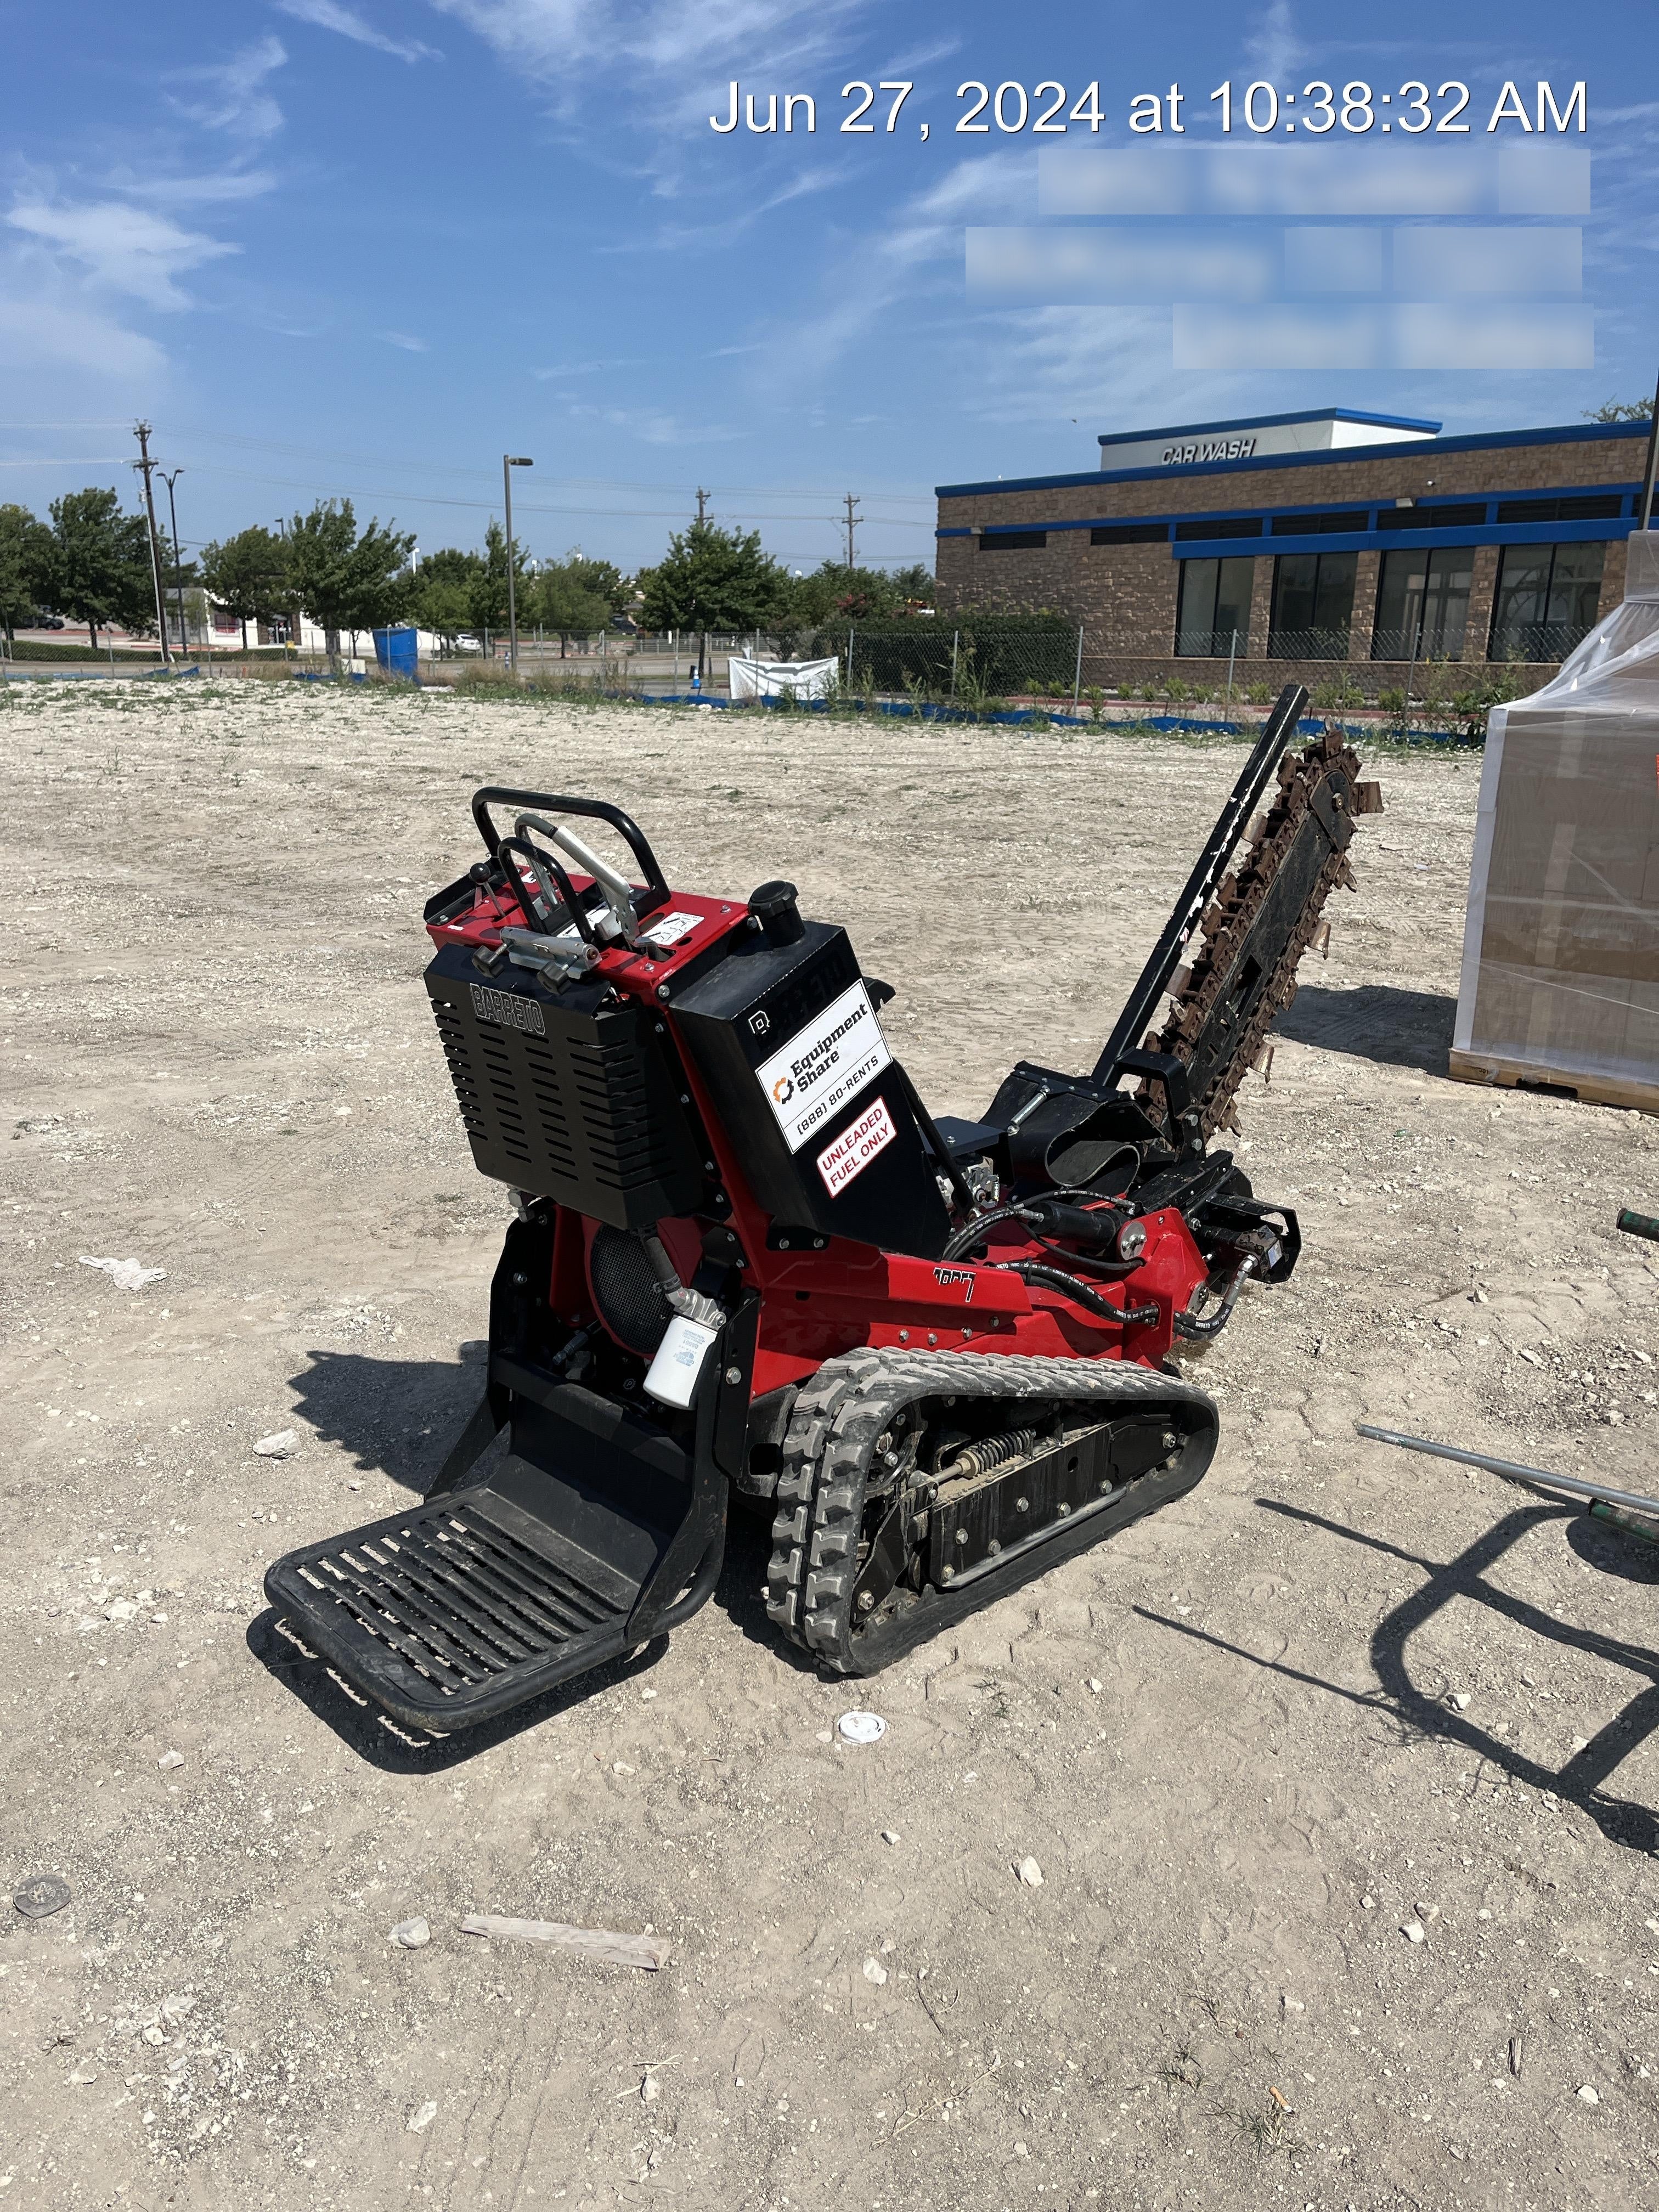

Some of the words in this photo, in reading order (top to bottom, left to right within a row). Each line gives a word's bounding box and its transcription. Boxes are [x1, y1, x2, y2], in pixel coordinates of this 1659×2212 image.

[1161, 444, 1198, 466] CAR
[1200, 439, 1256, 462] WASH
[470, 983, 545, 1035] BARRETO
[790, 1003, 868, 1079] Equipment
[797, 1050, 840, 1092] Share
[797, 1102, 827, 1135] (888)
[829, 1055, 879, 1105] 80-RENTS
[822, 1108, 882, 1170] UNLEADED
[830, 1156, 861, 1188] FUEL
[861, 1122, 888, 1157] ONLY
